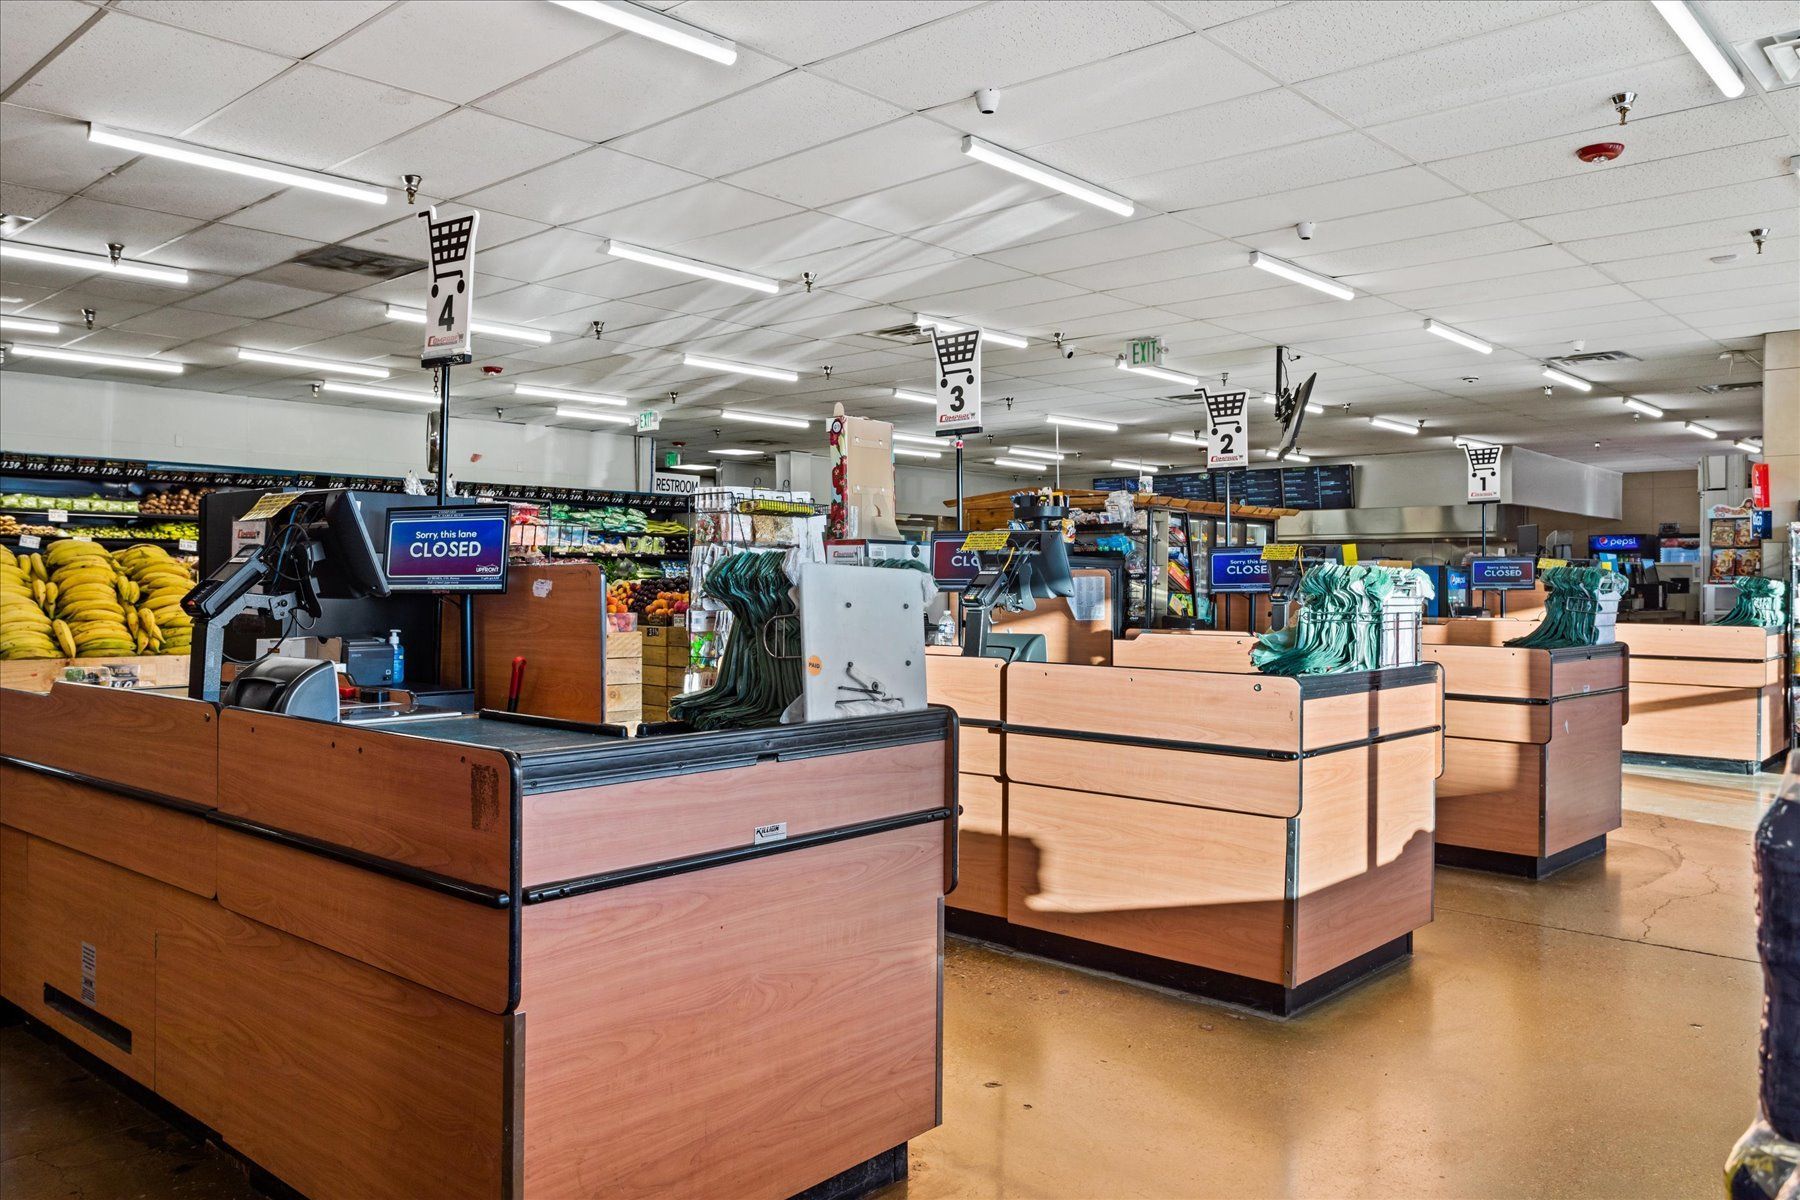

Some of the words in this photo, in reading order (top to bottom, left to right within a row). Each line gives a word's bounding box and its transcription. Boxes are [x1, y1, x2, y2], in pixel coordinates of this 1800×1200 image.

[438, 294, 455, 332] 4
[1132, 340, 1157, 365] EXIT
[949, 385, 965, 412] 3
[640, 411, 653, 429] EXIT
[1220, 433, 1234, 454] 2
[655, 478, 699, 493] RESTROOM
[1479, 477, 1486, 491] 1
[440, 530, 457, 538] this
[458, 530, 478, 538] lane
[1610, 537, 1636, 546] pepsi
[409, 541, 482, 558] CLOSED
[951, 555, 980, 567] CLO
[1226, 565, 1270, 575] CLOSE
[1484, 569, 1522, 577] CLOSED
